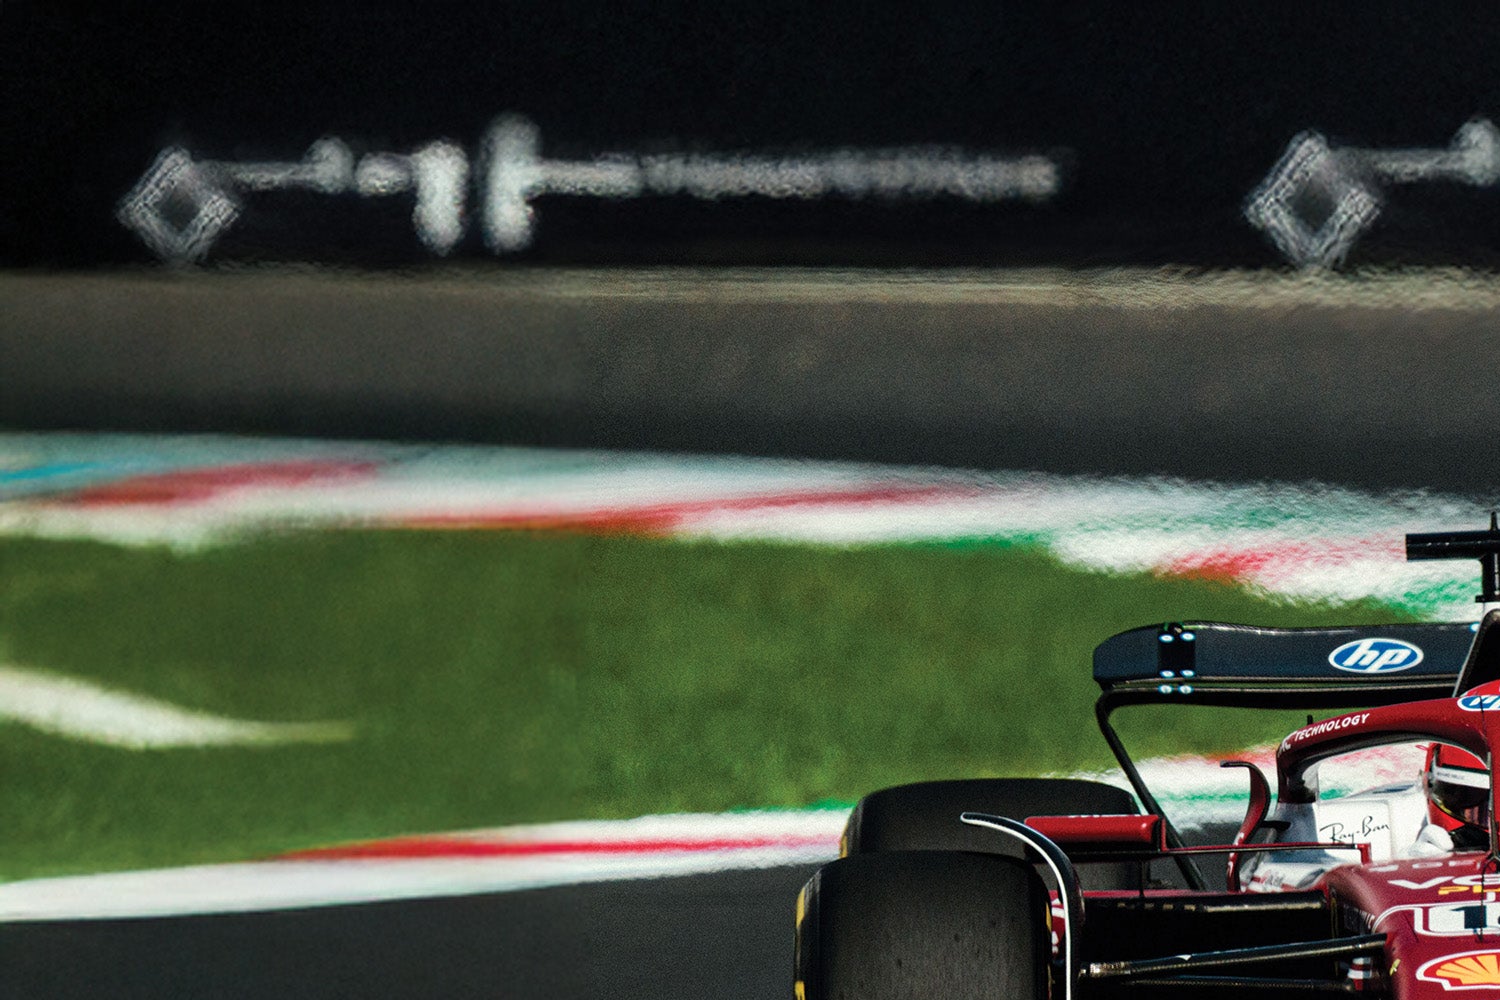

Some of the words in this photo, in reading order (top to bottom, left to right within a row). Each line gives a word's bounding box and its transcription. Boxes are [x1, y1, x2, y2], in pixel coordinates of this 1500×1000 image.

[1341, 638, 1412, 673] hp
[1294, 713, 1370, 742] TECHNOLOGY
[1319, 815, 1390, 844] Ray-Ban
